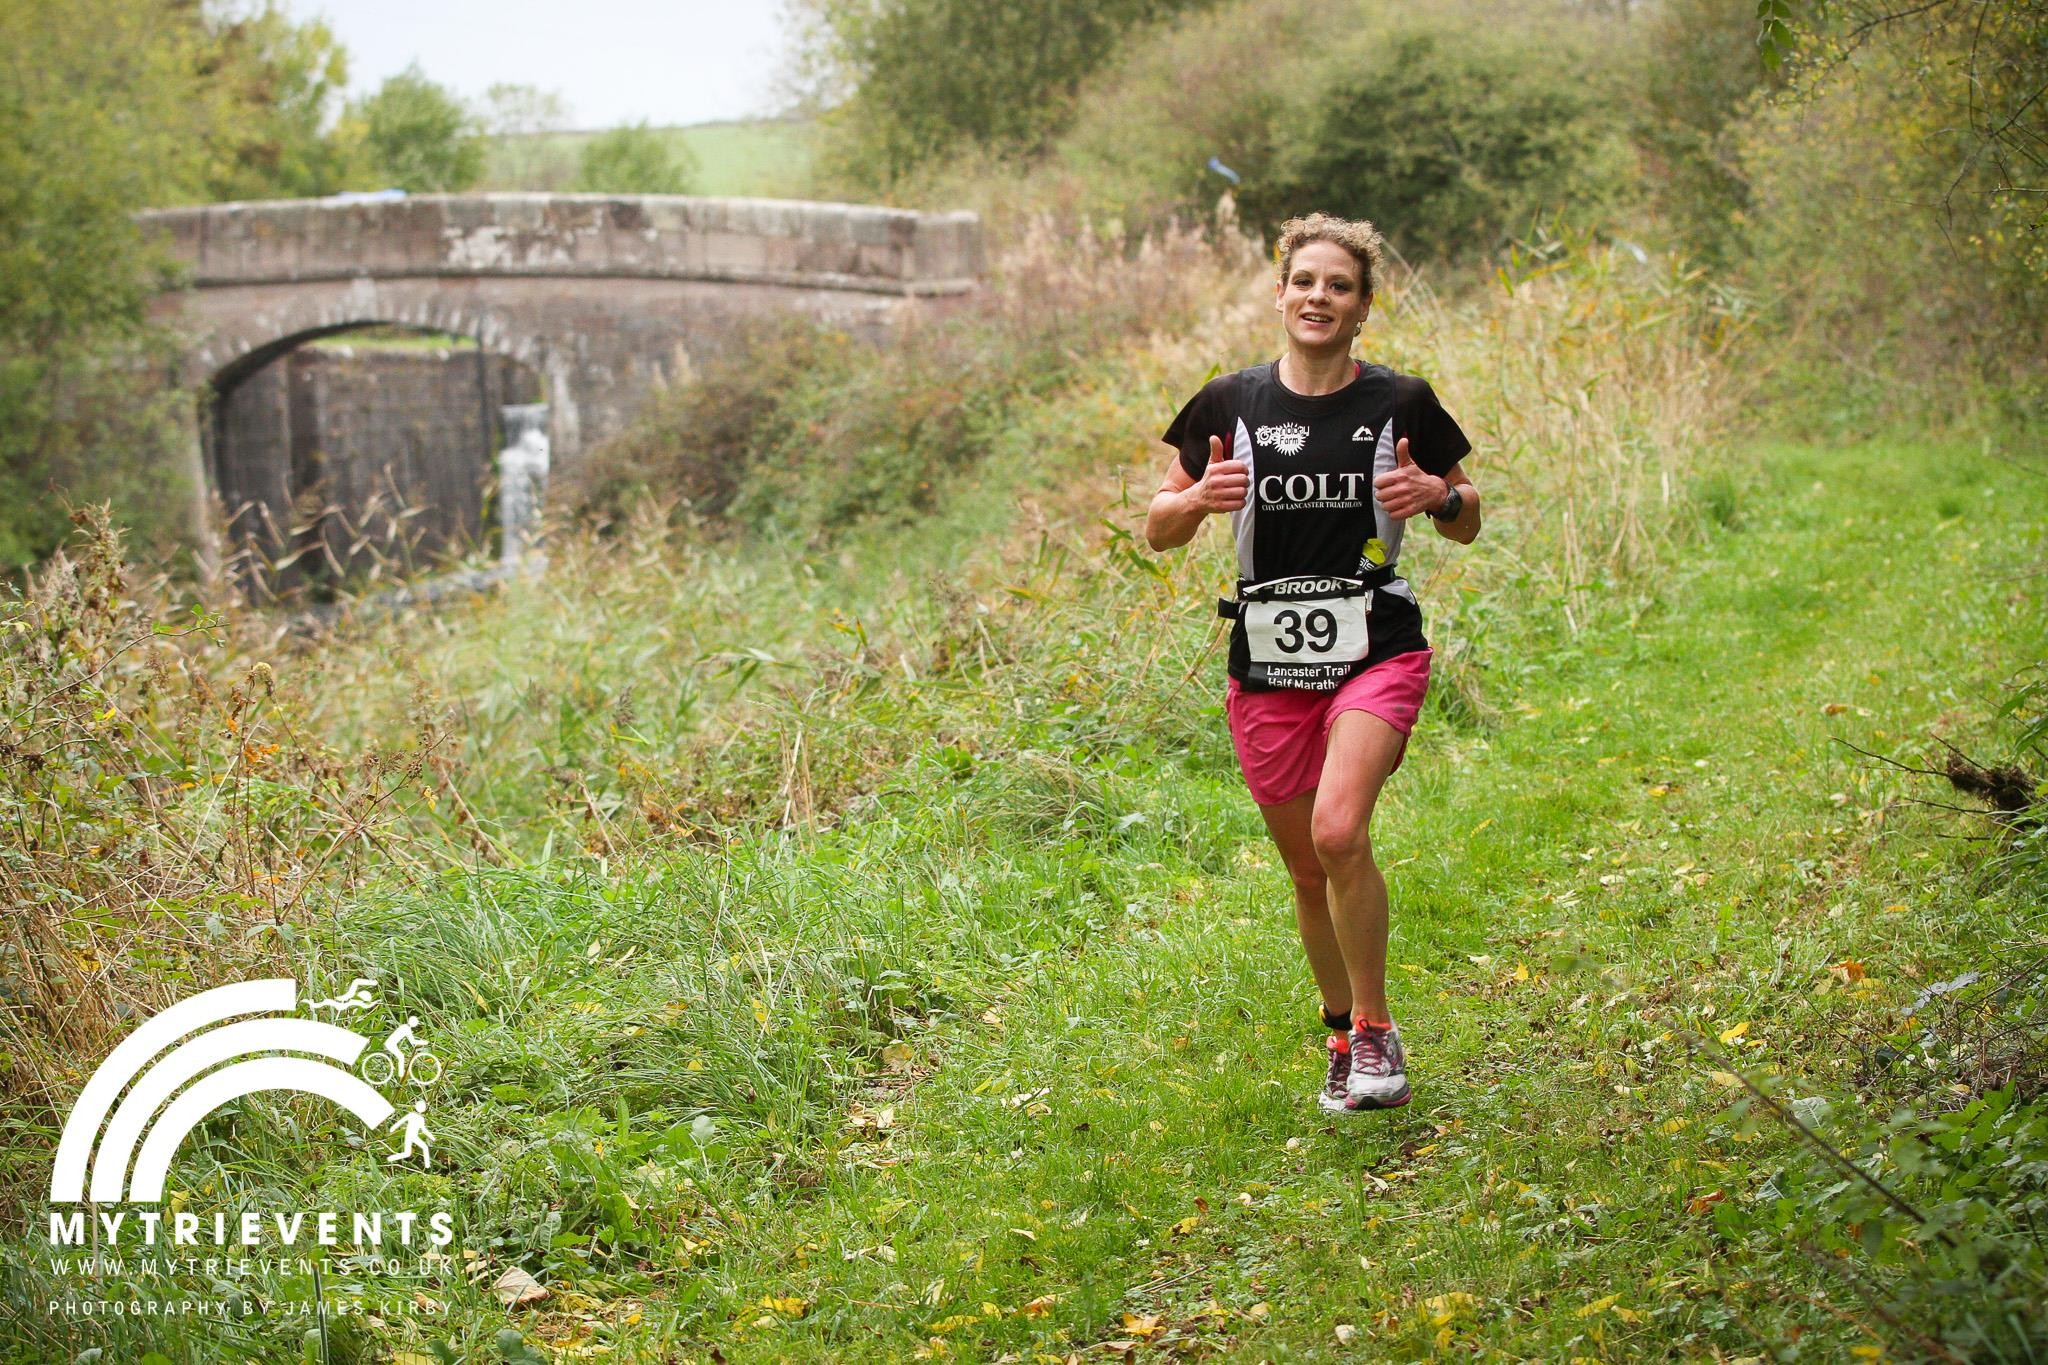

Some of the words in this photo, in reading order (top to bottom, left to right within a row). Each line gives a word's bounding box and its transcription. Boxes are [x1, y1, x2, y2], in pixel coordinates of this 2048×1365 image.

[1279, 435, 1299, 445] Farm
[1258, 473, 1365, 504] COLT
[1261, 503, 1275, 512] CITY
[1276, 502, 1285, 511] OF
[1286, 500, 1325, 511] LANCASTER
[1326, 500, 1363, 509] TRIATHLON
[1273, 608, 1338, 654] 39
[1266, 664, 1321, 677] Lancaster
[1268, 677, 1293, 688] Half
[1294, 678, 1339, 690] Marath
